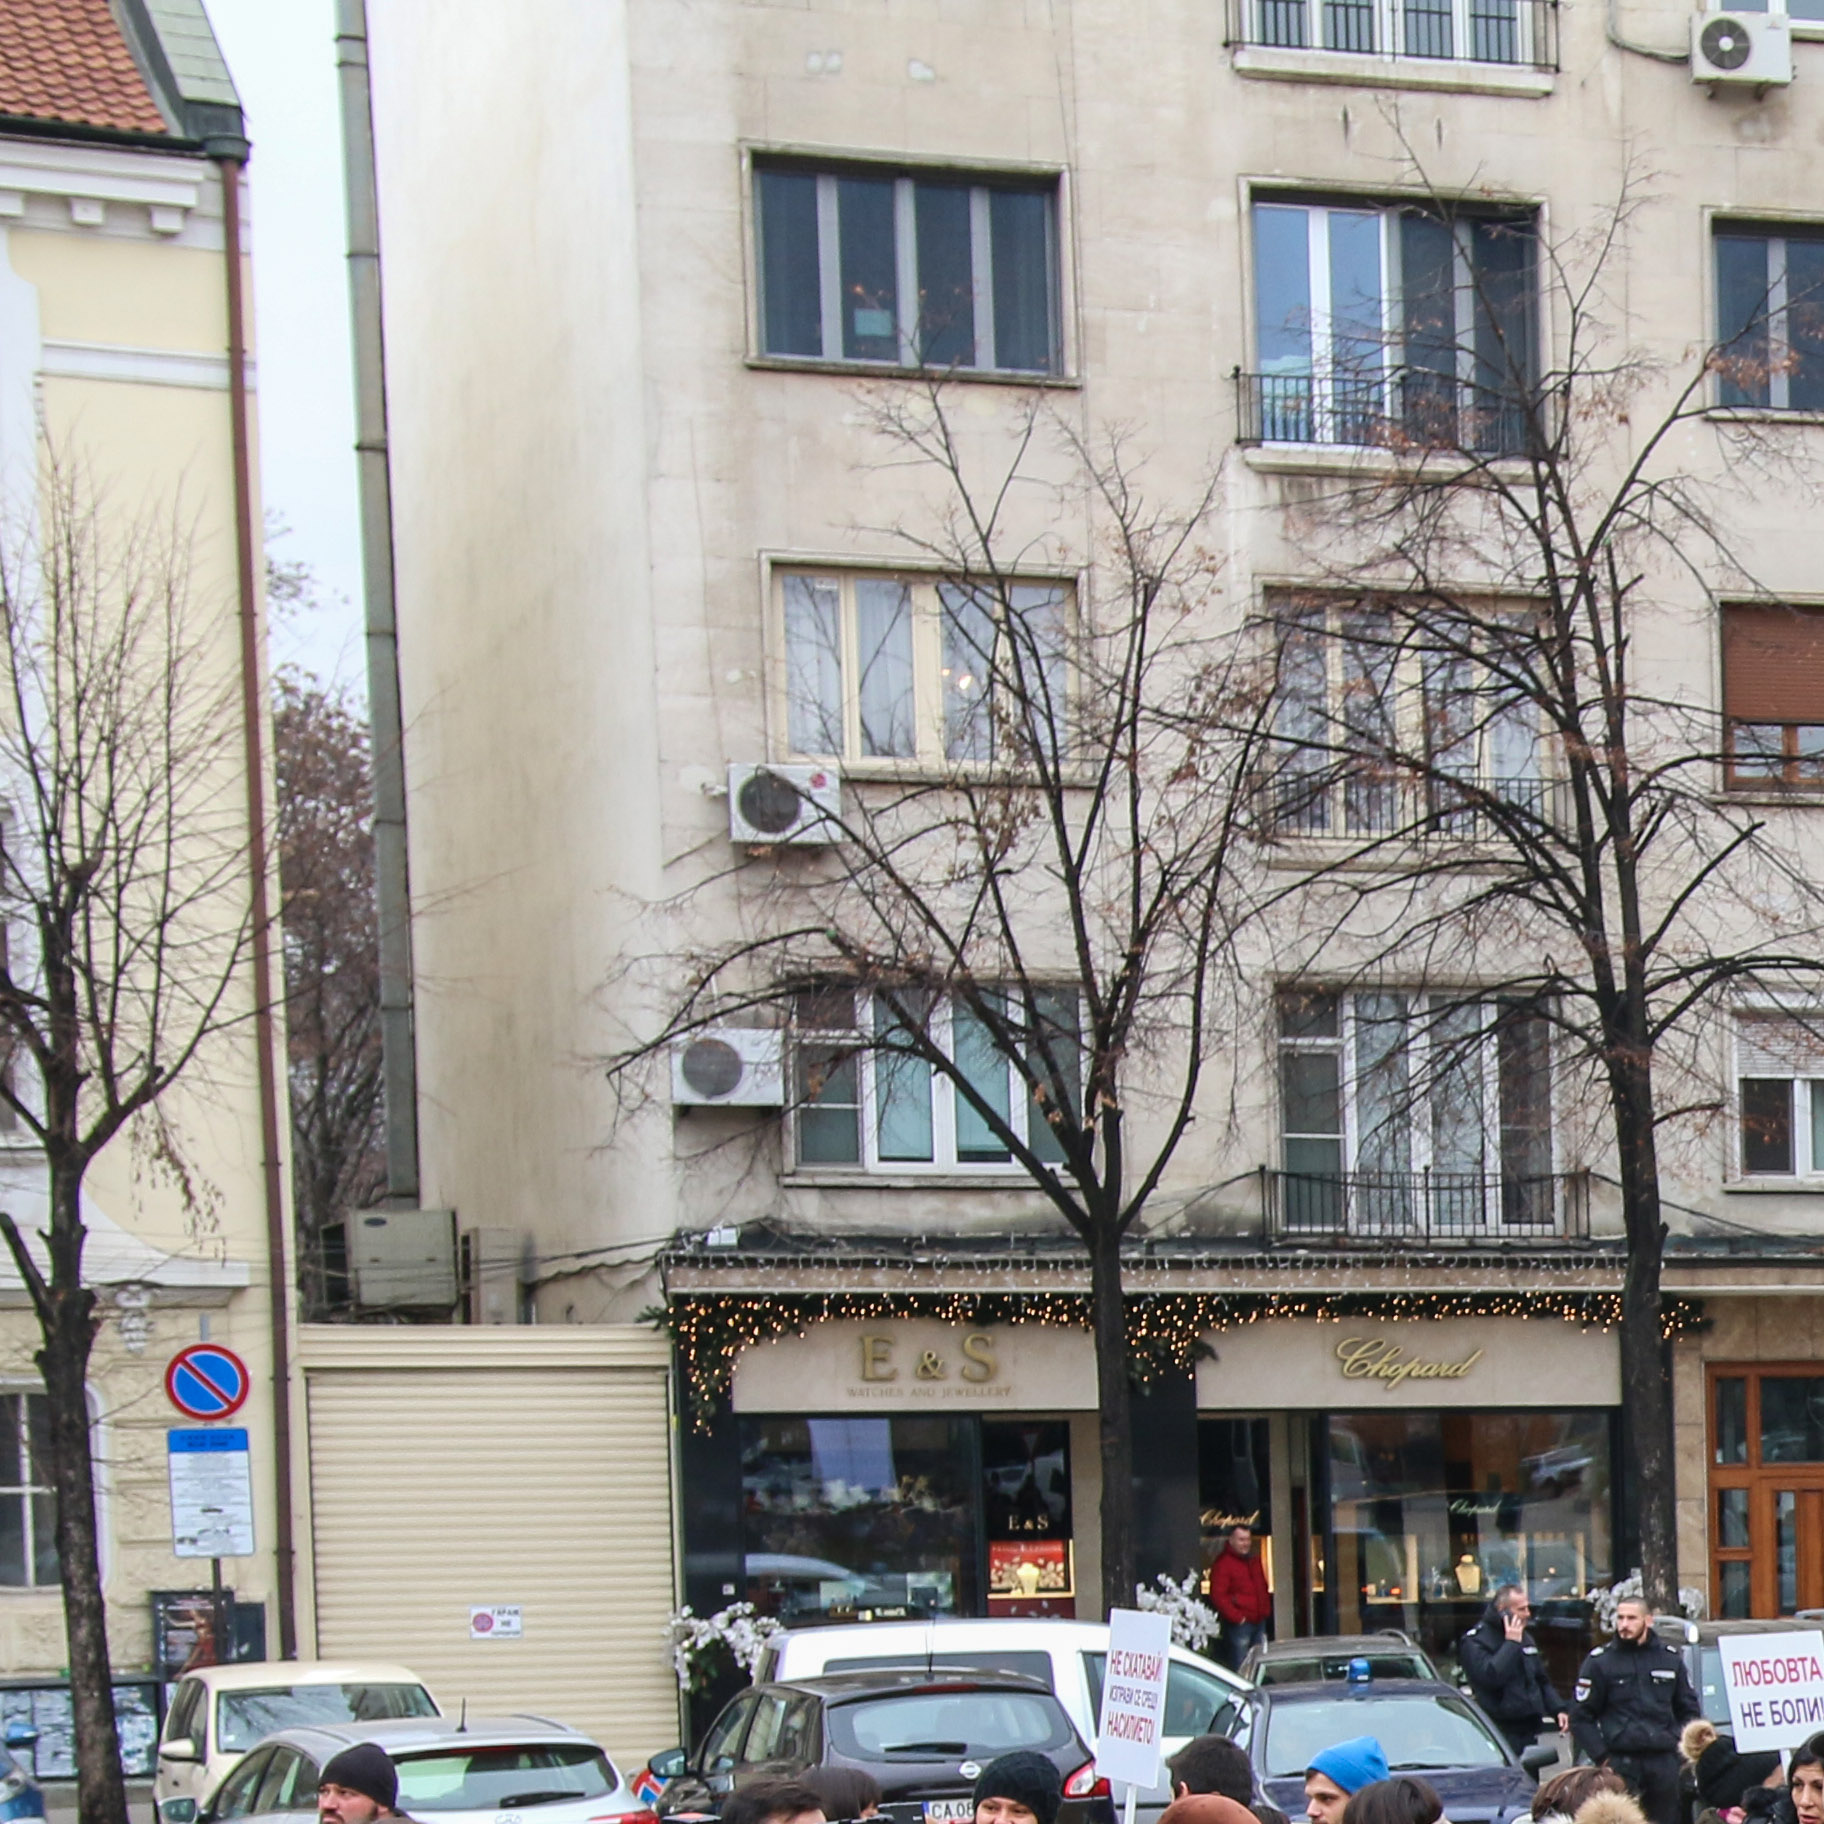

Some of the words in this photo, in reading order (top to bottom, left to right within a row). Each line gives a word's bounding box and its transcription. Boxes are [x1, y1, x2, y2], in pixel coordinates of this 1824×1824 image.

[860, 1336, 898, 1382] E
[915, 1350, 946, 1381] &
[961, 1333, 998, 1383] S
[1336, 1337, 1483, 1390] Chopard
[1732, 1656, 1824, 1687] ЛЮБОВТА
[1741, 1701, 1765, 1728] НЕ
